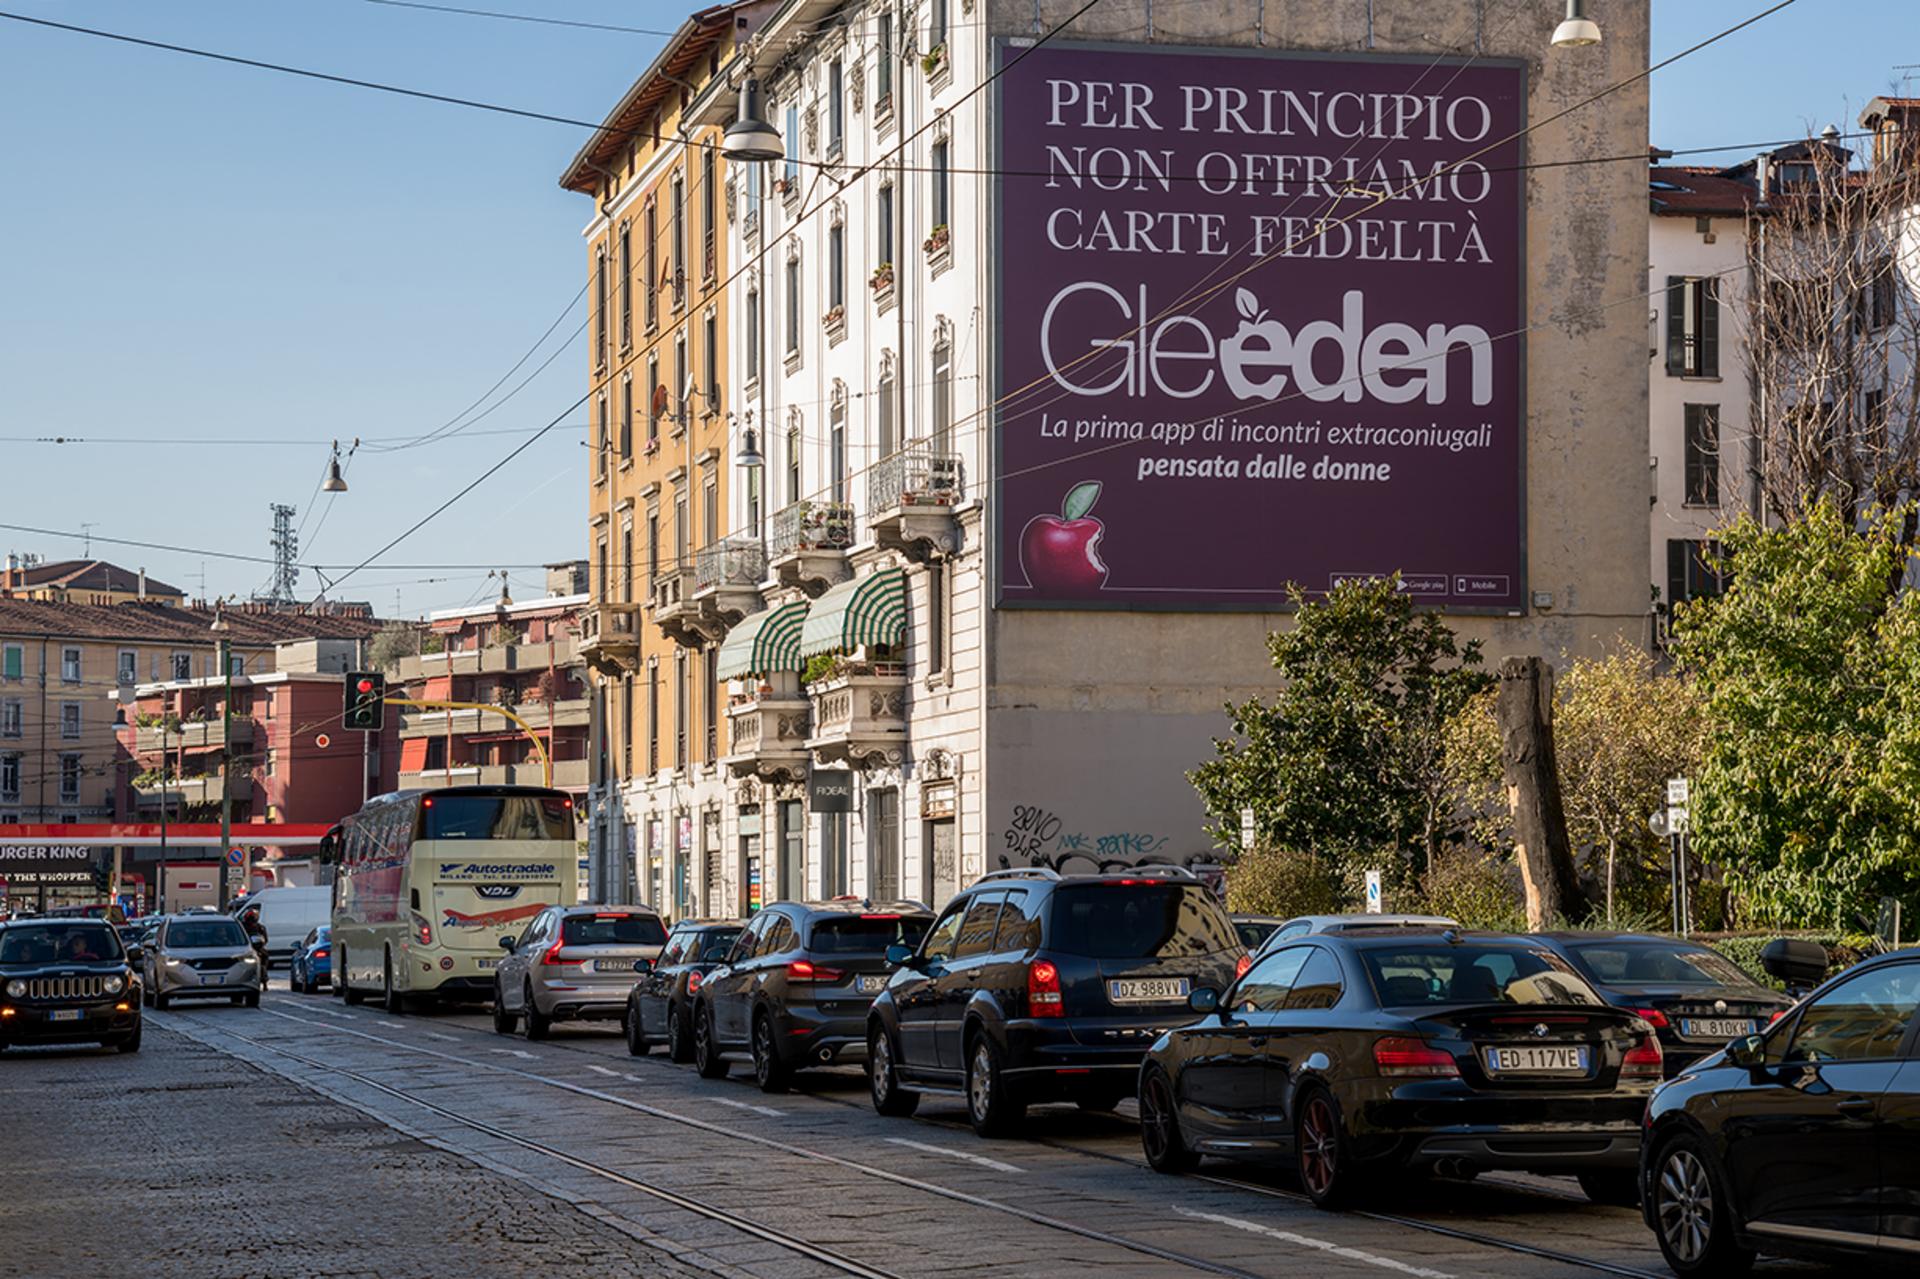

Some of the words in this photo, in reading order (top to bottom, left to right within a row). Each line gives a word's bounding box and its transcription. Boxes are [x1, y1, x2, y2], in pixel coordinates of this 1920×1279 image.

[1045, 79, 1163, 131] PER
[1179, 85, 1492, 142] PRINCIPIO
[1045, 145, 1174, 192] NON
[1197, 152, 1492, 203] OFFRIAMO
[1046, 208, 1229, 256] CARTE
[1250, 210, 1493, 263] FEDELTÀ
[1040, 413, 1068, 437] La
[1074, 415, 1143, 442] prima
[1151, 421, 1196, 445] app
[1202, 418, 1225, 441] di
[1231, 419, 1321, 443] incontri
[1327, 422, 1493, 452] extraconiugali
[1137, 454, 1240, 480] pensata
[1245, 453, 1307, 479] dalle
[1312, 455, 1391, 481] donne
[1471, 581, 1497, 590] Mobile
[50, 846, 88, 859] KING
[463, 863, 556, 874] Autostradale
[14, 872, 37, 882] THE
[39, 872, 92, 882] WHOPPER
[481, 886, 513, 896] VDL
[1120, 982, 1137, 996] DZ
[1141, 981, 1179, 996] 988VV
[1690, 1020, 1705, 1034] DL
[1500, 1050, 1520, 1068] ED
[1527, 1049, 1578, 1068] 117VE
